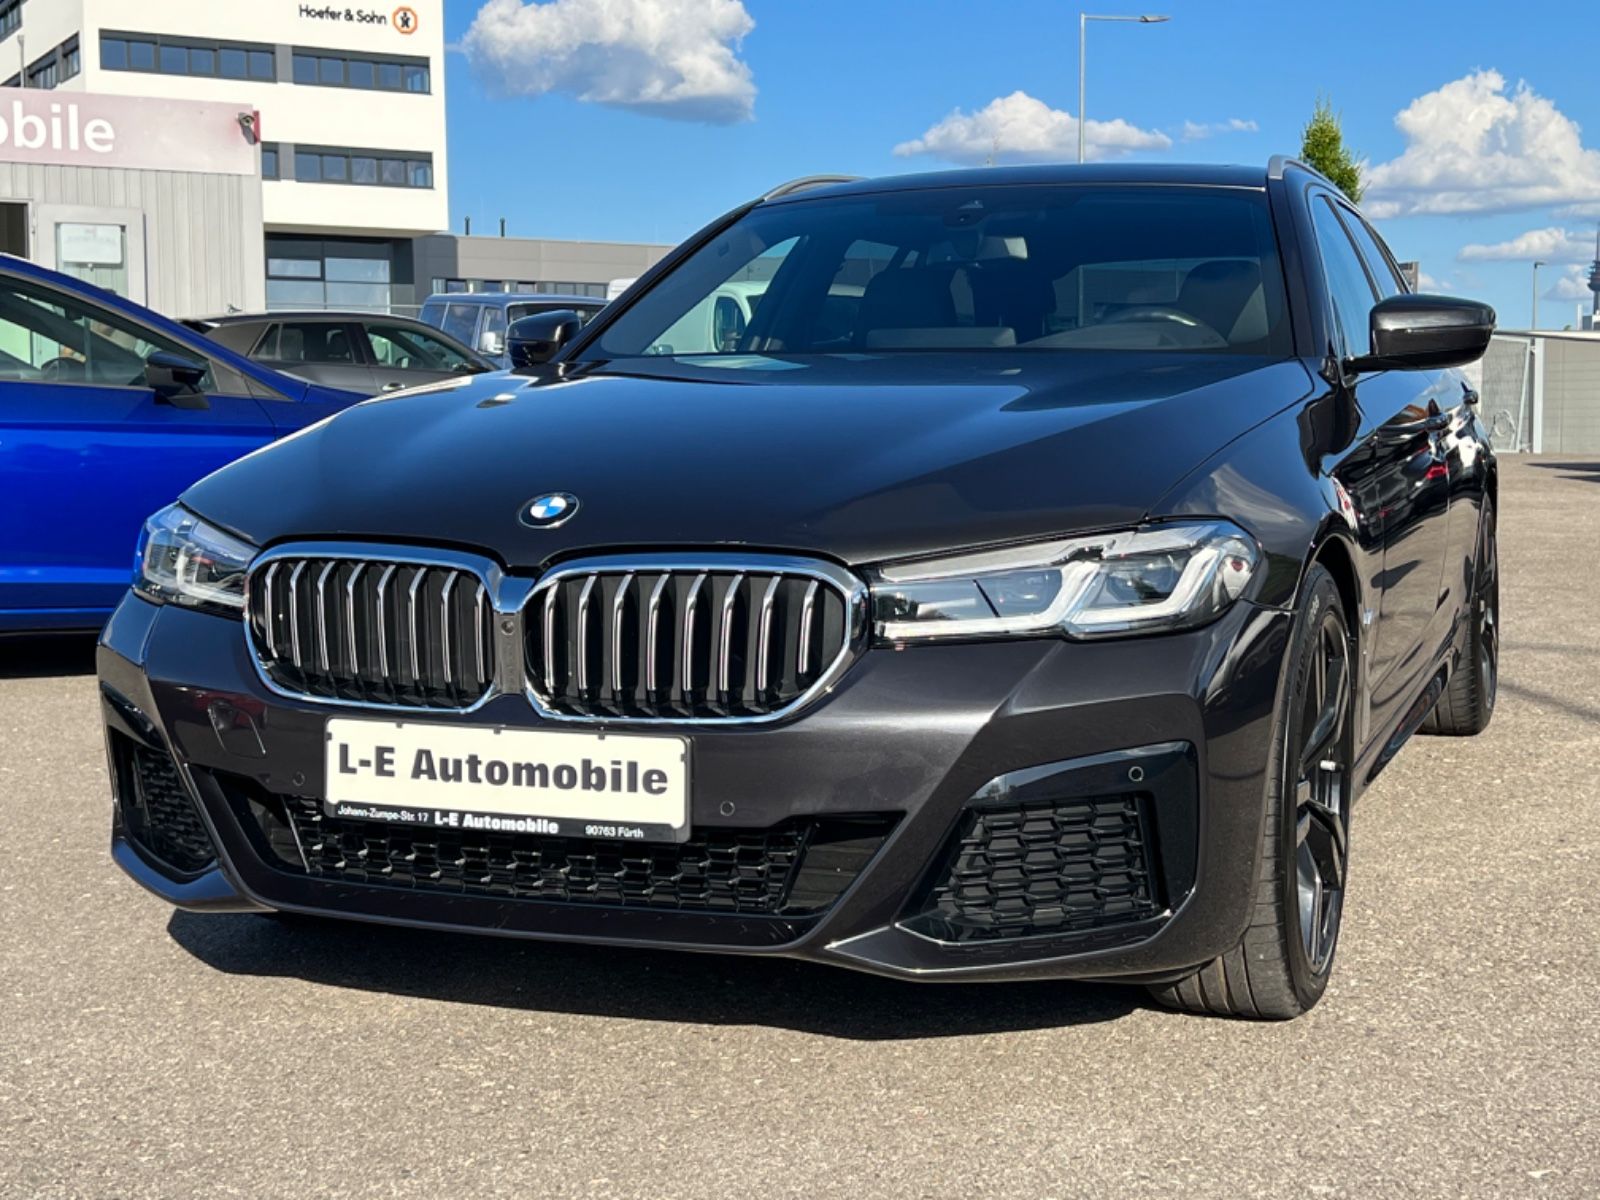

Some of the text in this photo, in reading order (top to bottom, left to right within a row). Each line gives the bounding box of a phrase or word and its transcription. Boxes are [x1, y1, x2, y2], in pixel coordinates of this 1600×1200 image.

[299, 4, 387, 25] Hoefer & Sohn
[0, 100, 115, 153] bile
[338, 743, 668, 795] L-E Automobile
[417, 812, 429, 823] 17
[434, 811, 559, 834] L-E Automobile
[585, 825, 644, 838] 90763 Fürth
